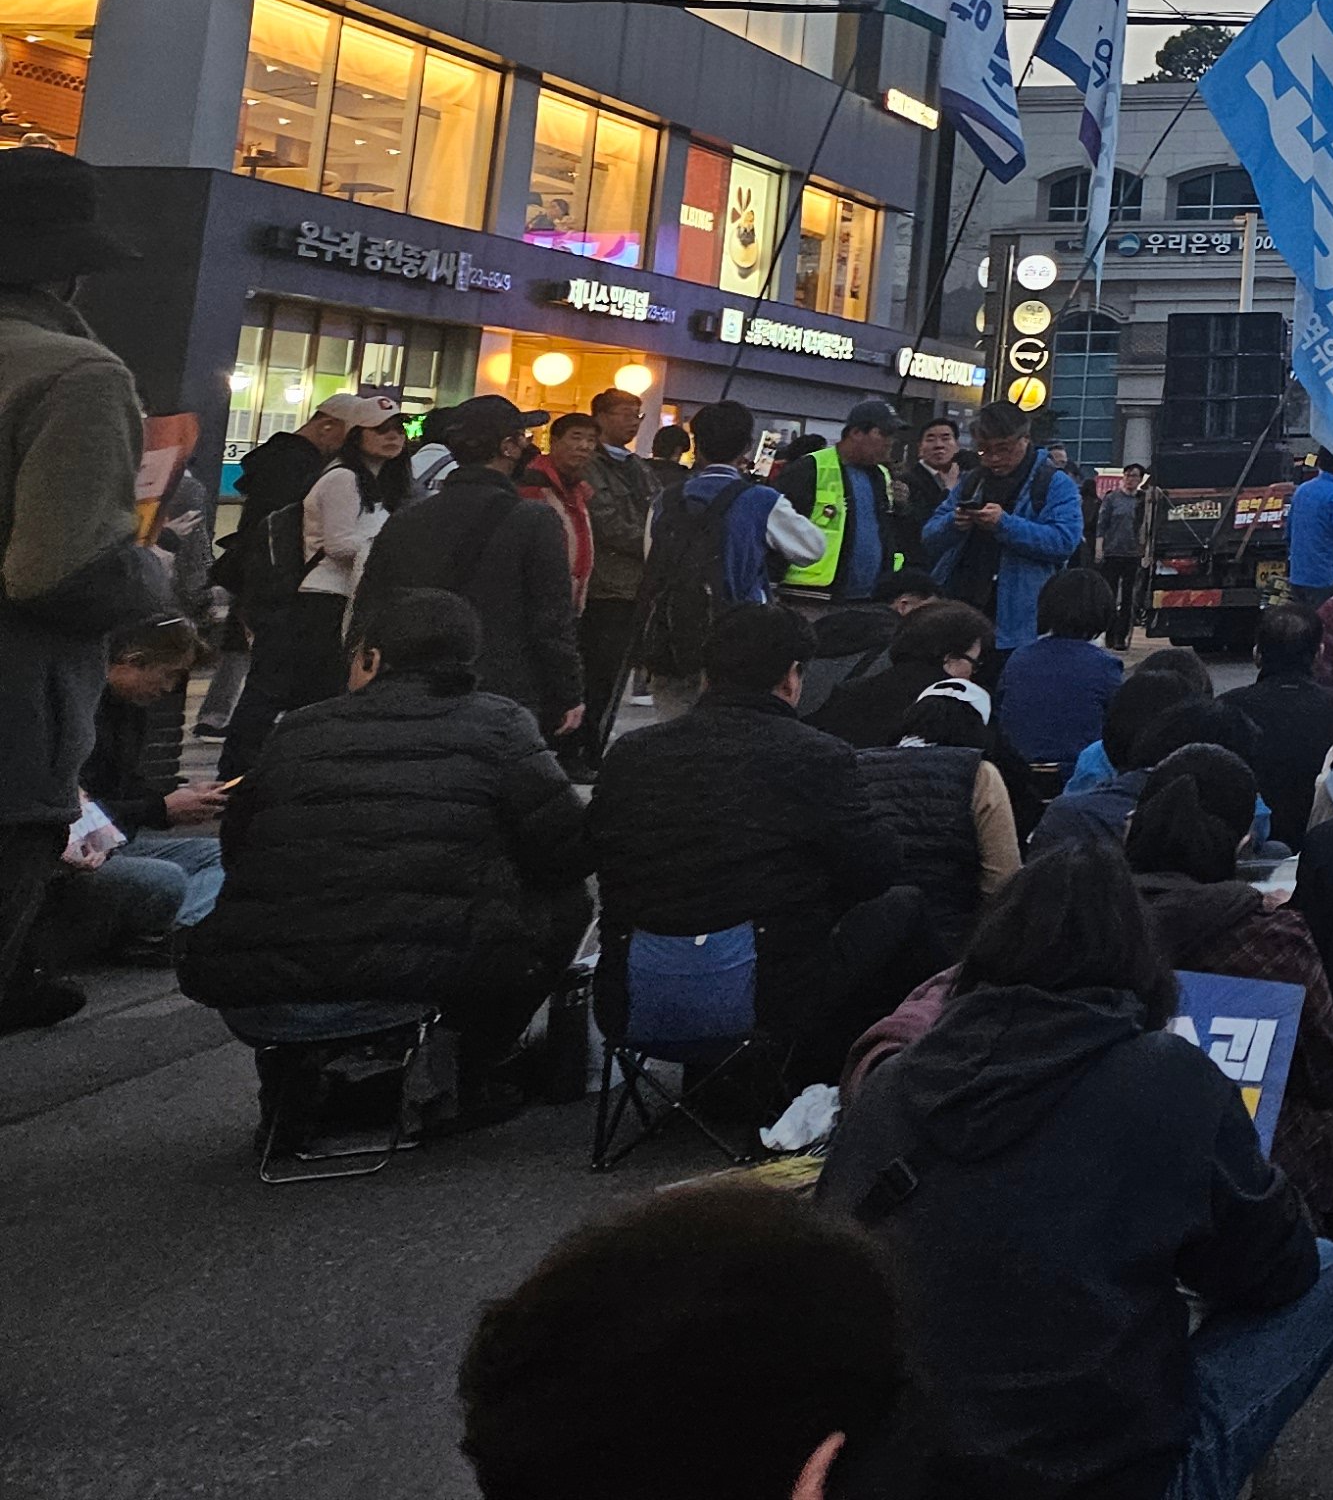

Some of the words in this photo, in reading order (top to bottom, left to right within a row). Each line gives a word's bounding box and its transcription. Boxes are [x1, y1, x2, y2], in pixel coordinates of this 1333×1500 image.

[297, 221, 361, 267] 온누리
[364, 237, 457, 285] 공인중개사
[1144, 233, 1232, 256] 우리은행
